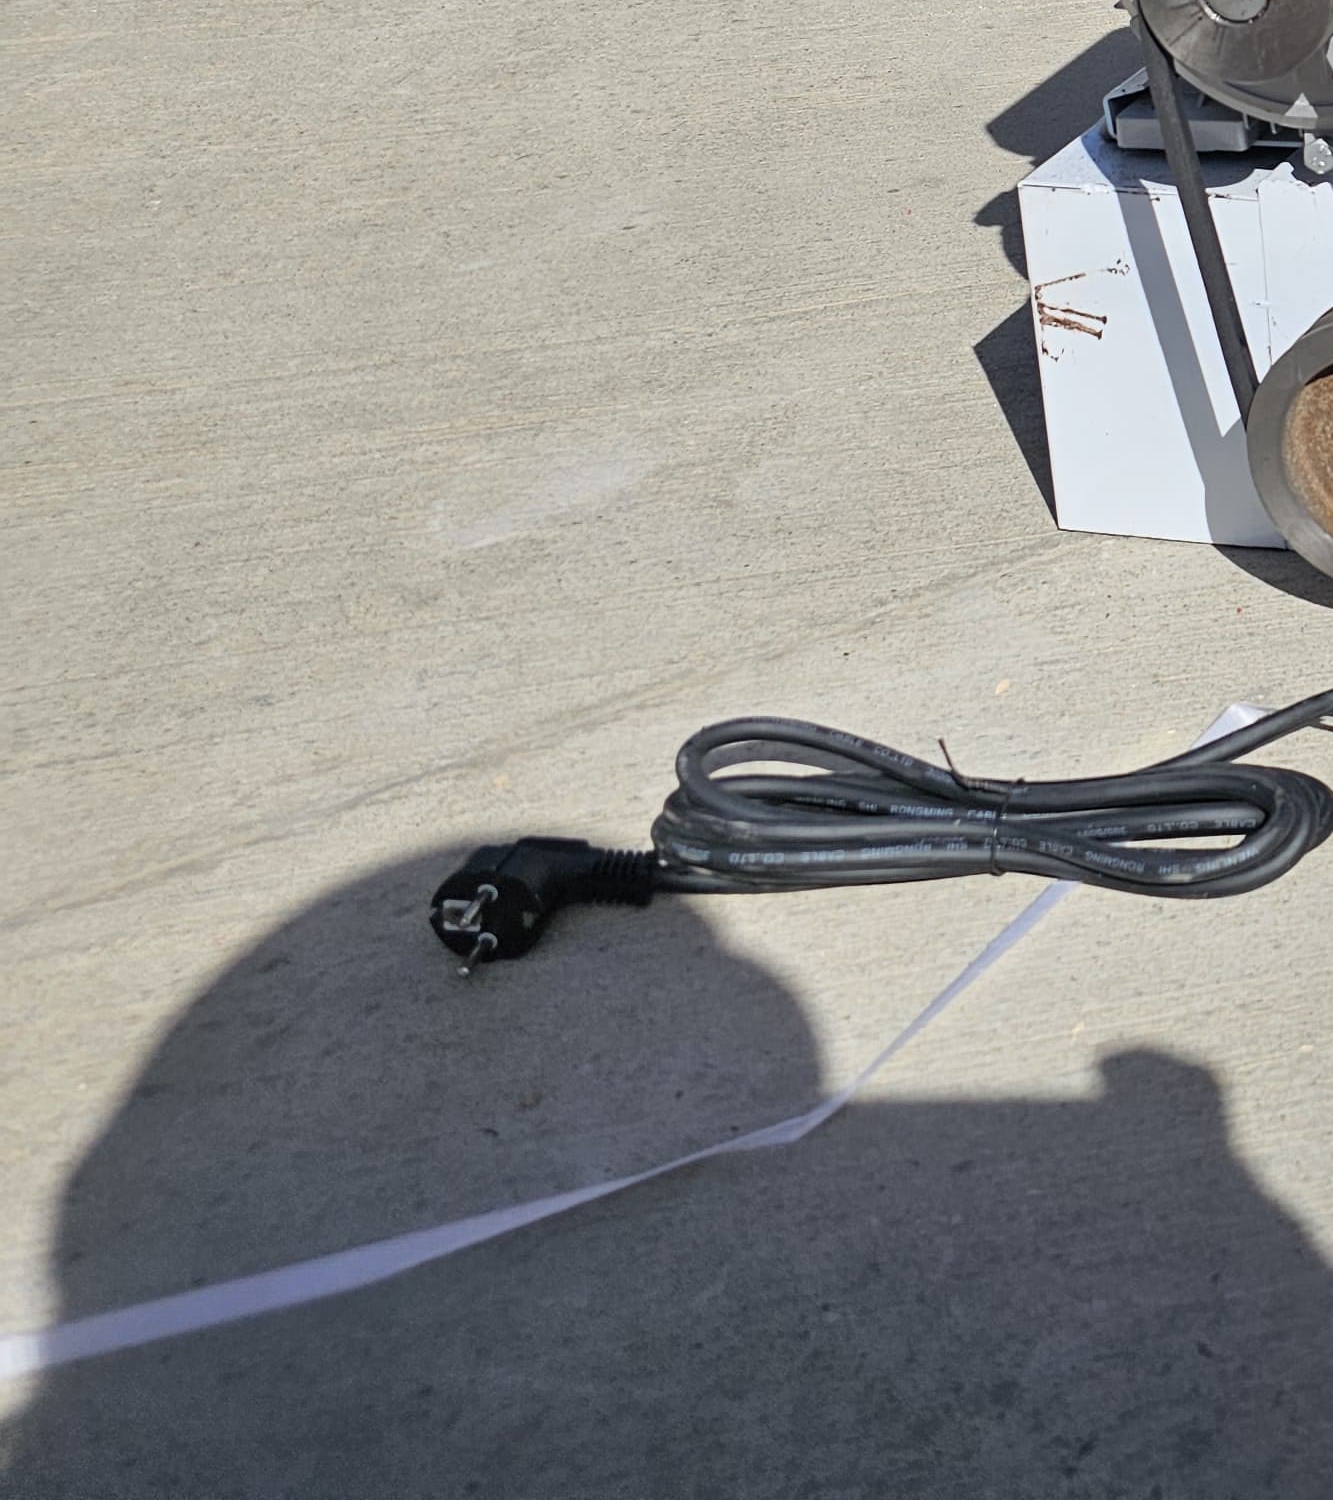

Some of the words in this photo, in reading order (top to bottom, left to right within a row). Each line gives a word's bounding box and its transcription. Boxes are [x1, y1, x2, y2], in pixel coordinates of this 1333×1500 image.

[889, 804, 954, 819] RONGMING
[1215, 818, 1256, 829] CABLE
[1086, 850, 1146, 874] RONGMING
